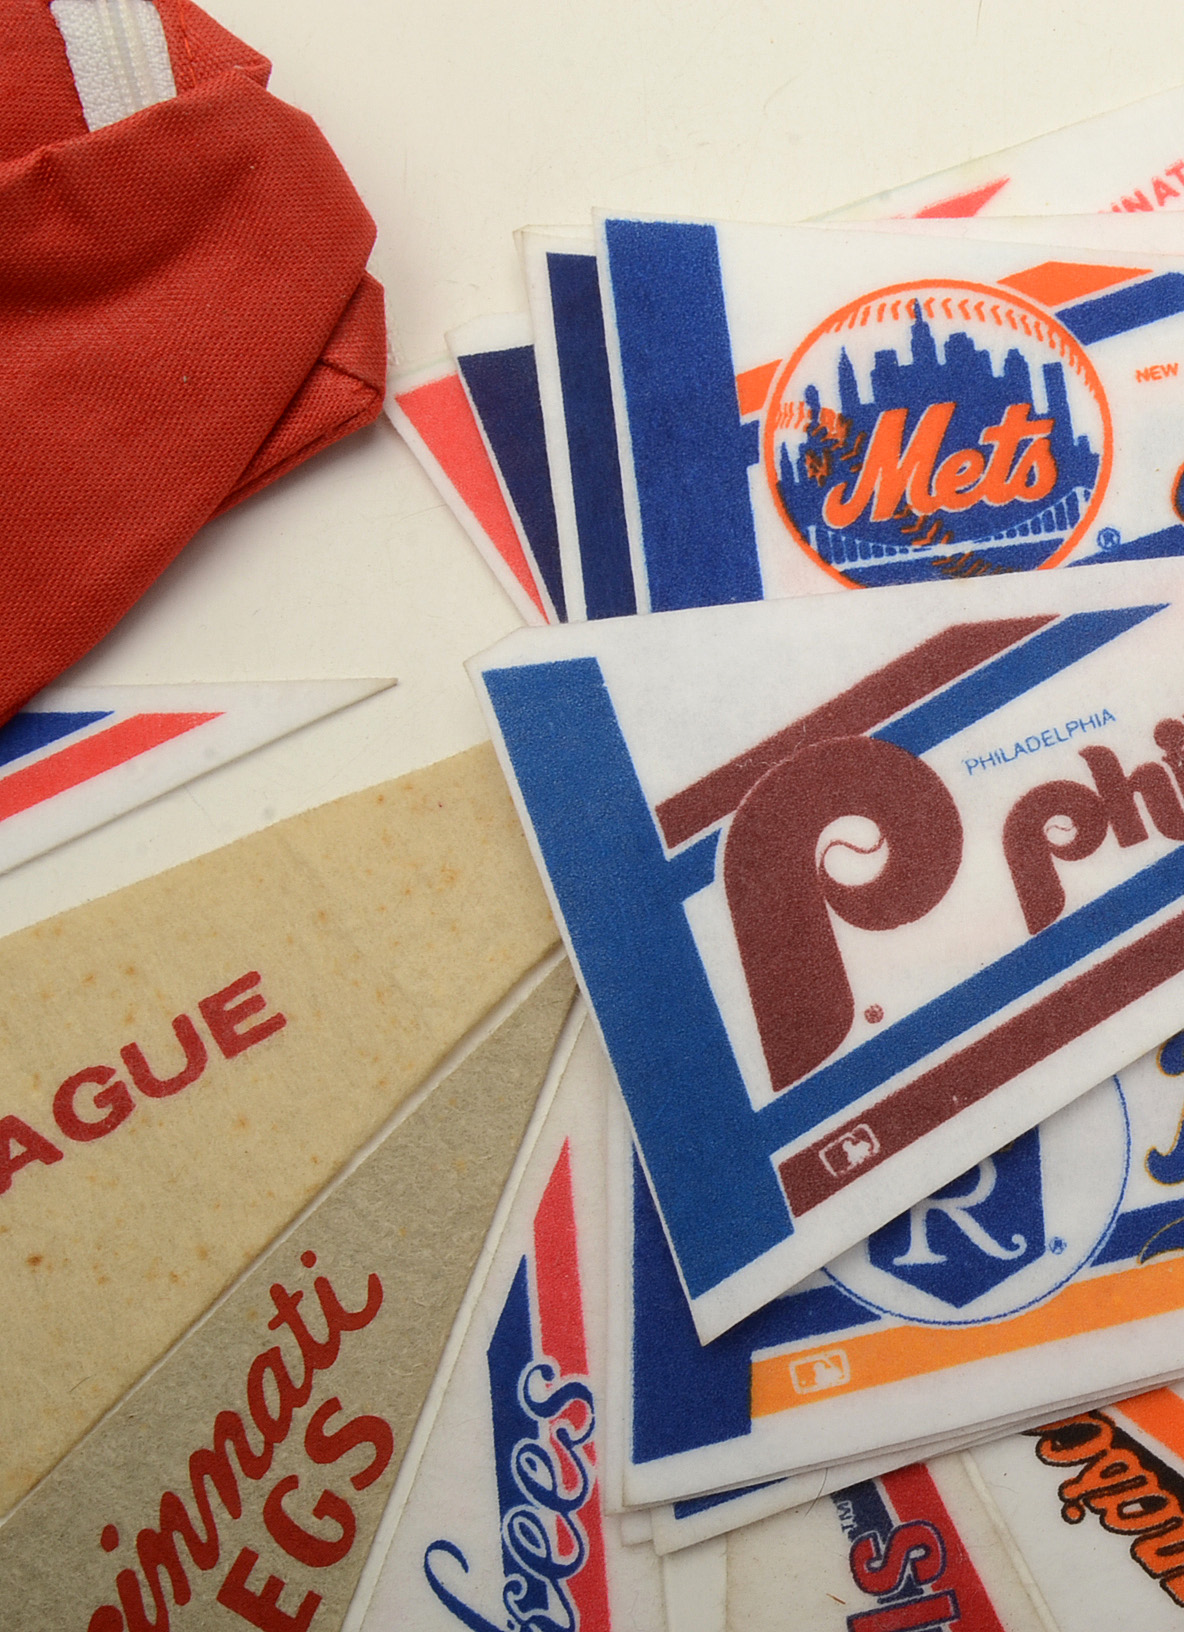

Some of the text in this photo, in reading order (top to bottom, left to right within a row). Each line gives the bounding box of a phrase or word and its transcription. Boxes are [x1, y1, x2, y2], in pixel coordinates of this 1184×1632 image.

[1136, 362, 1179, 383] NEW
[822, 402, 1058, 529] Mets
[963, 709, 1116, 776] PHILADELPHIA
[0, 971, 287, 1194] AGUE
